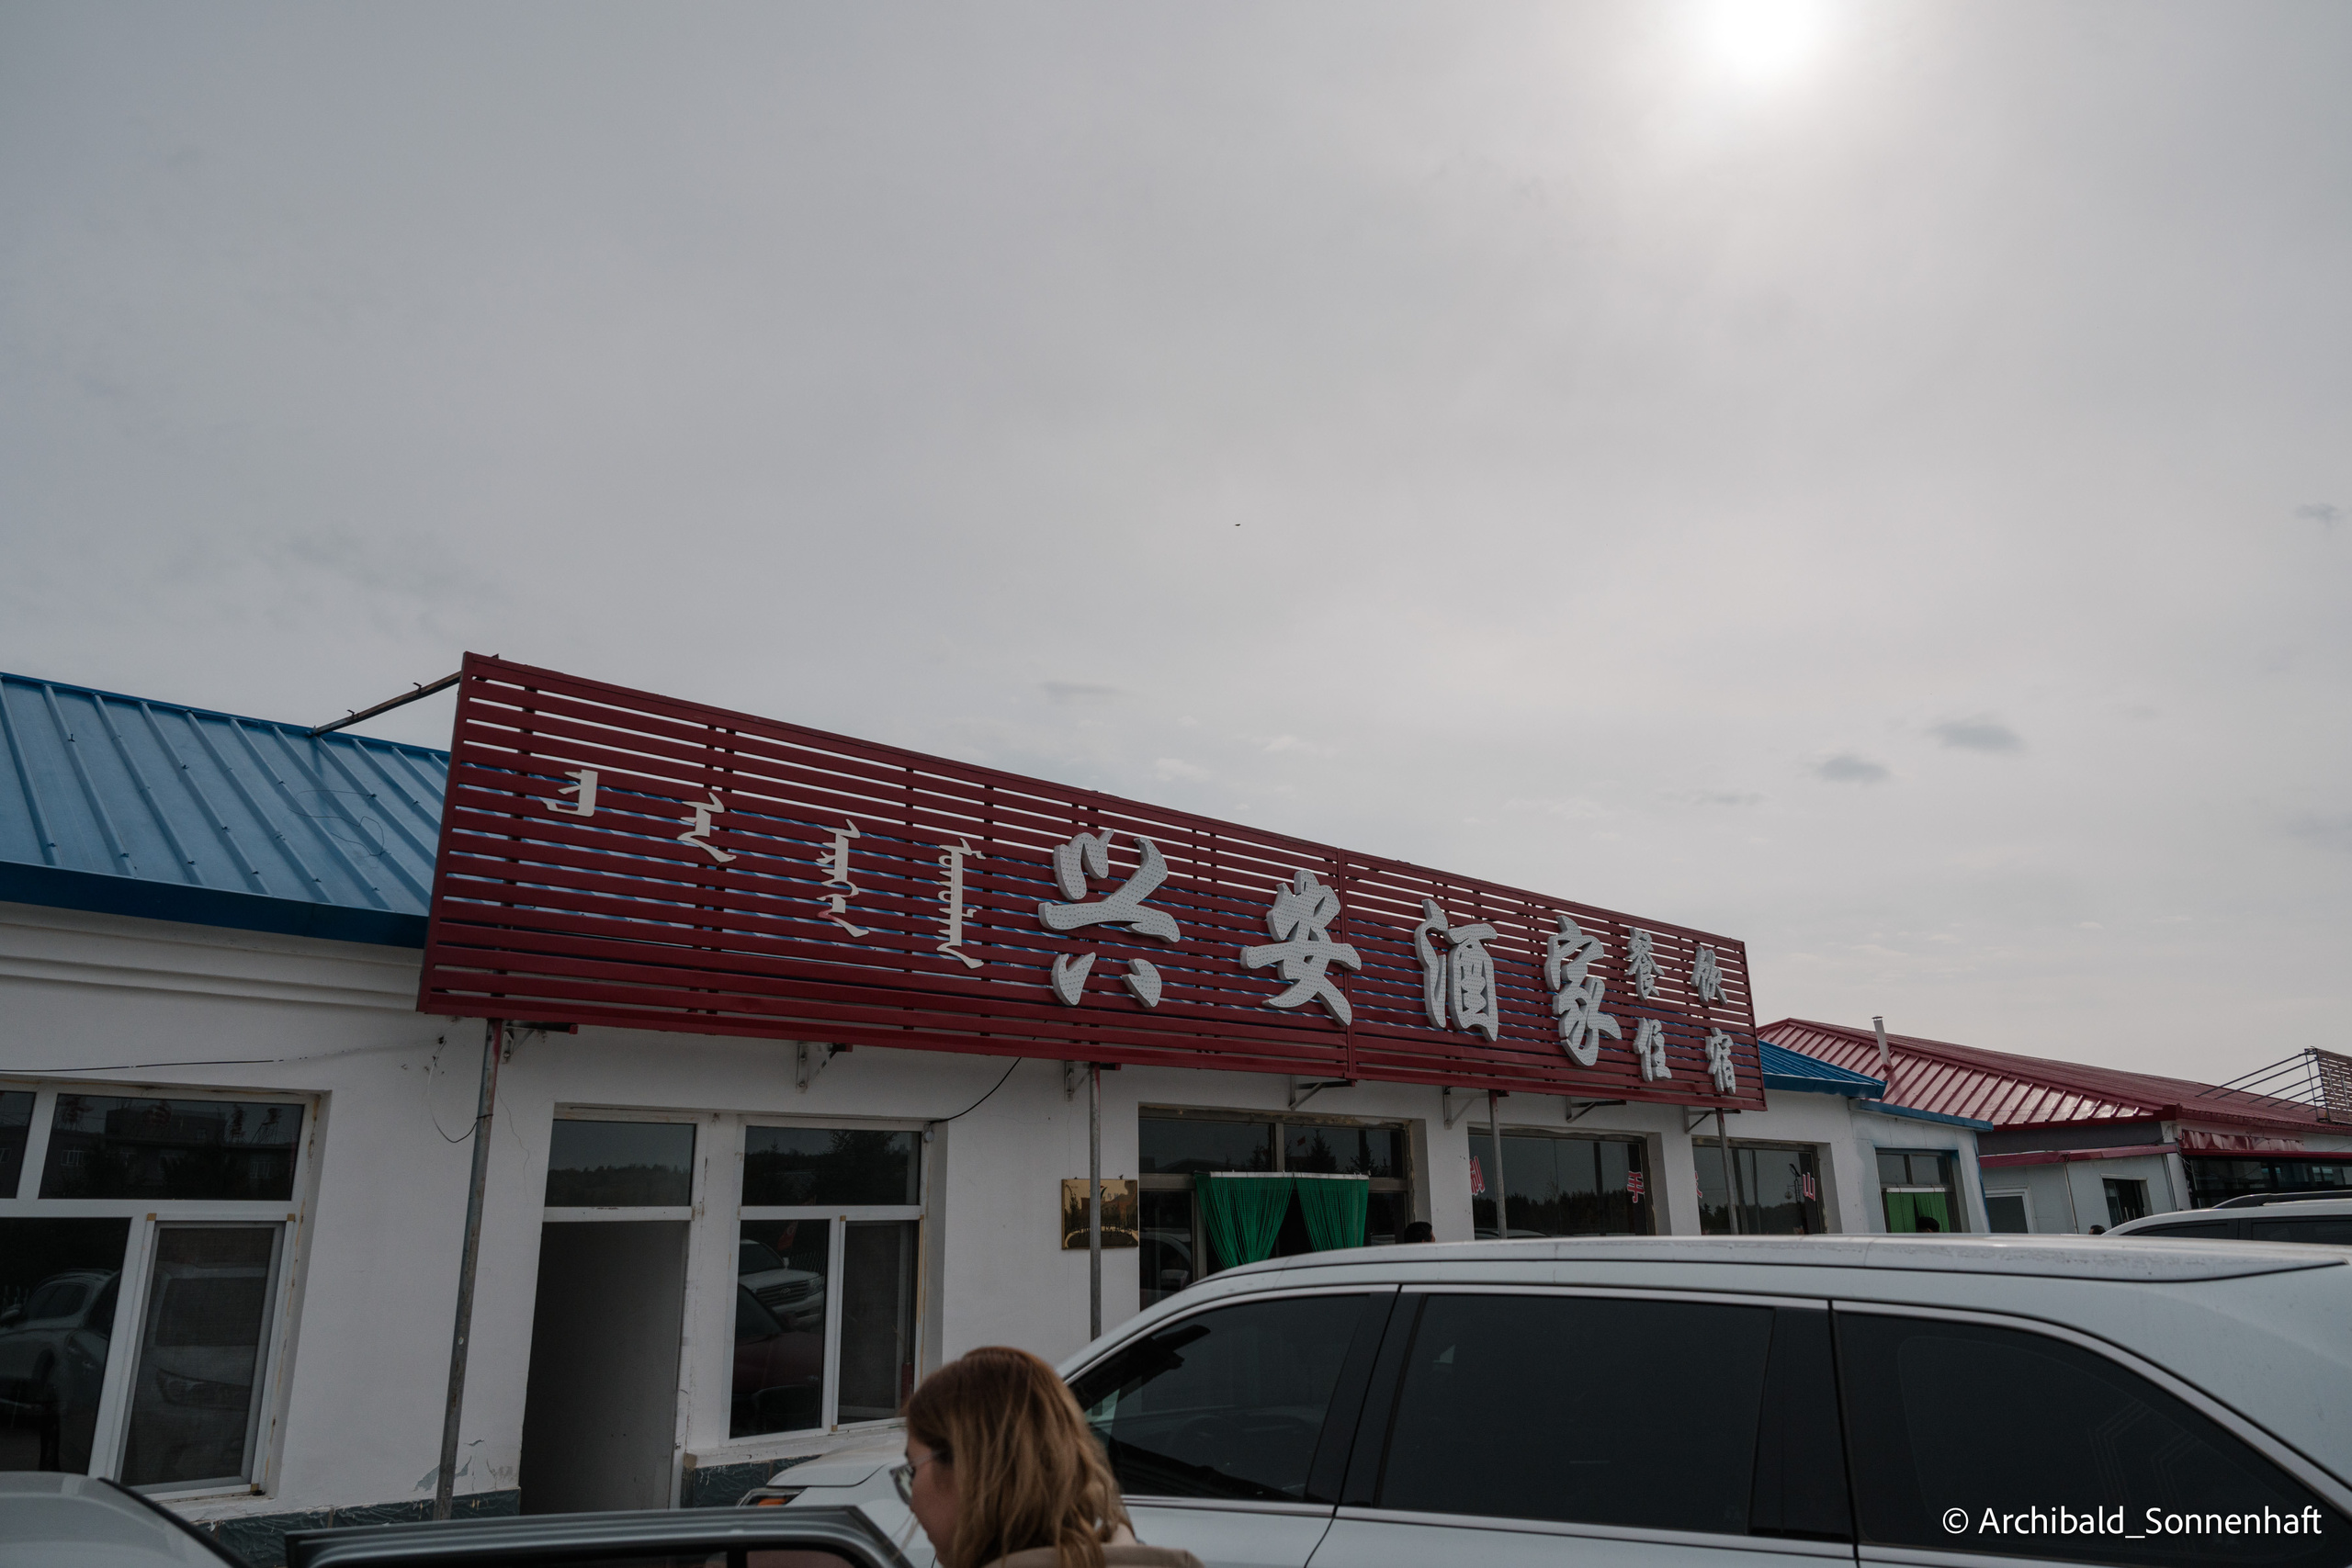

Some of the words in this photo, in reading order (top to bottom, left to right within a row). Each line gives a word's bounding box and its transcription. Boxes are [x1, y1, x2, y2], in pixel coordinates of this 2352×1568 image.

[1038, 829, 1623, 1067] 兴安酒家
[1632, 1017, 1736, 1096] 住宿
